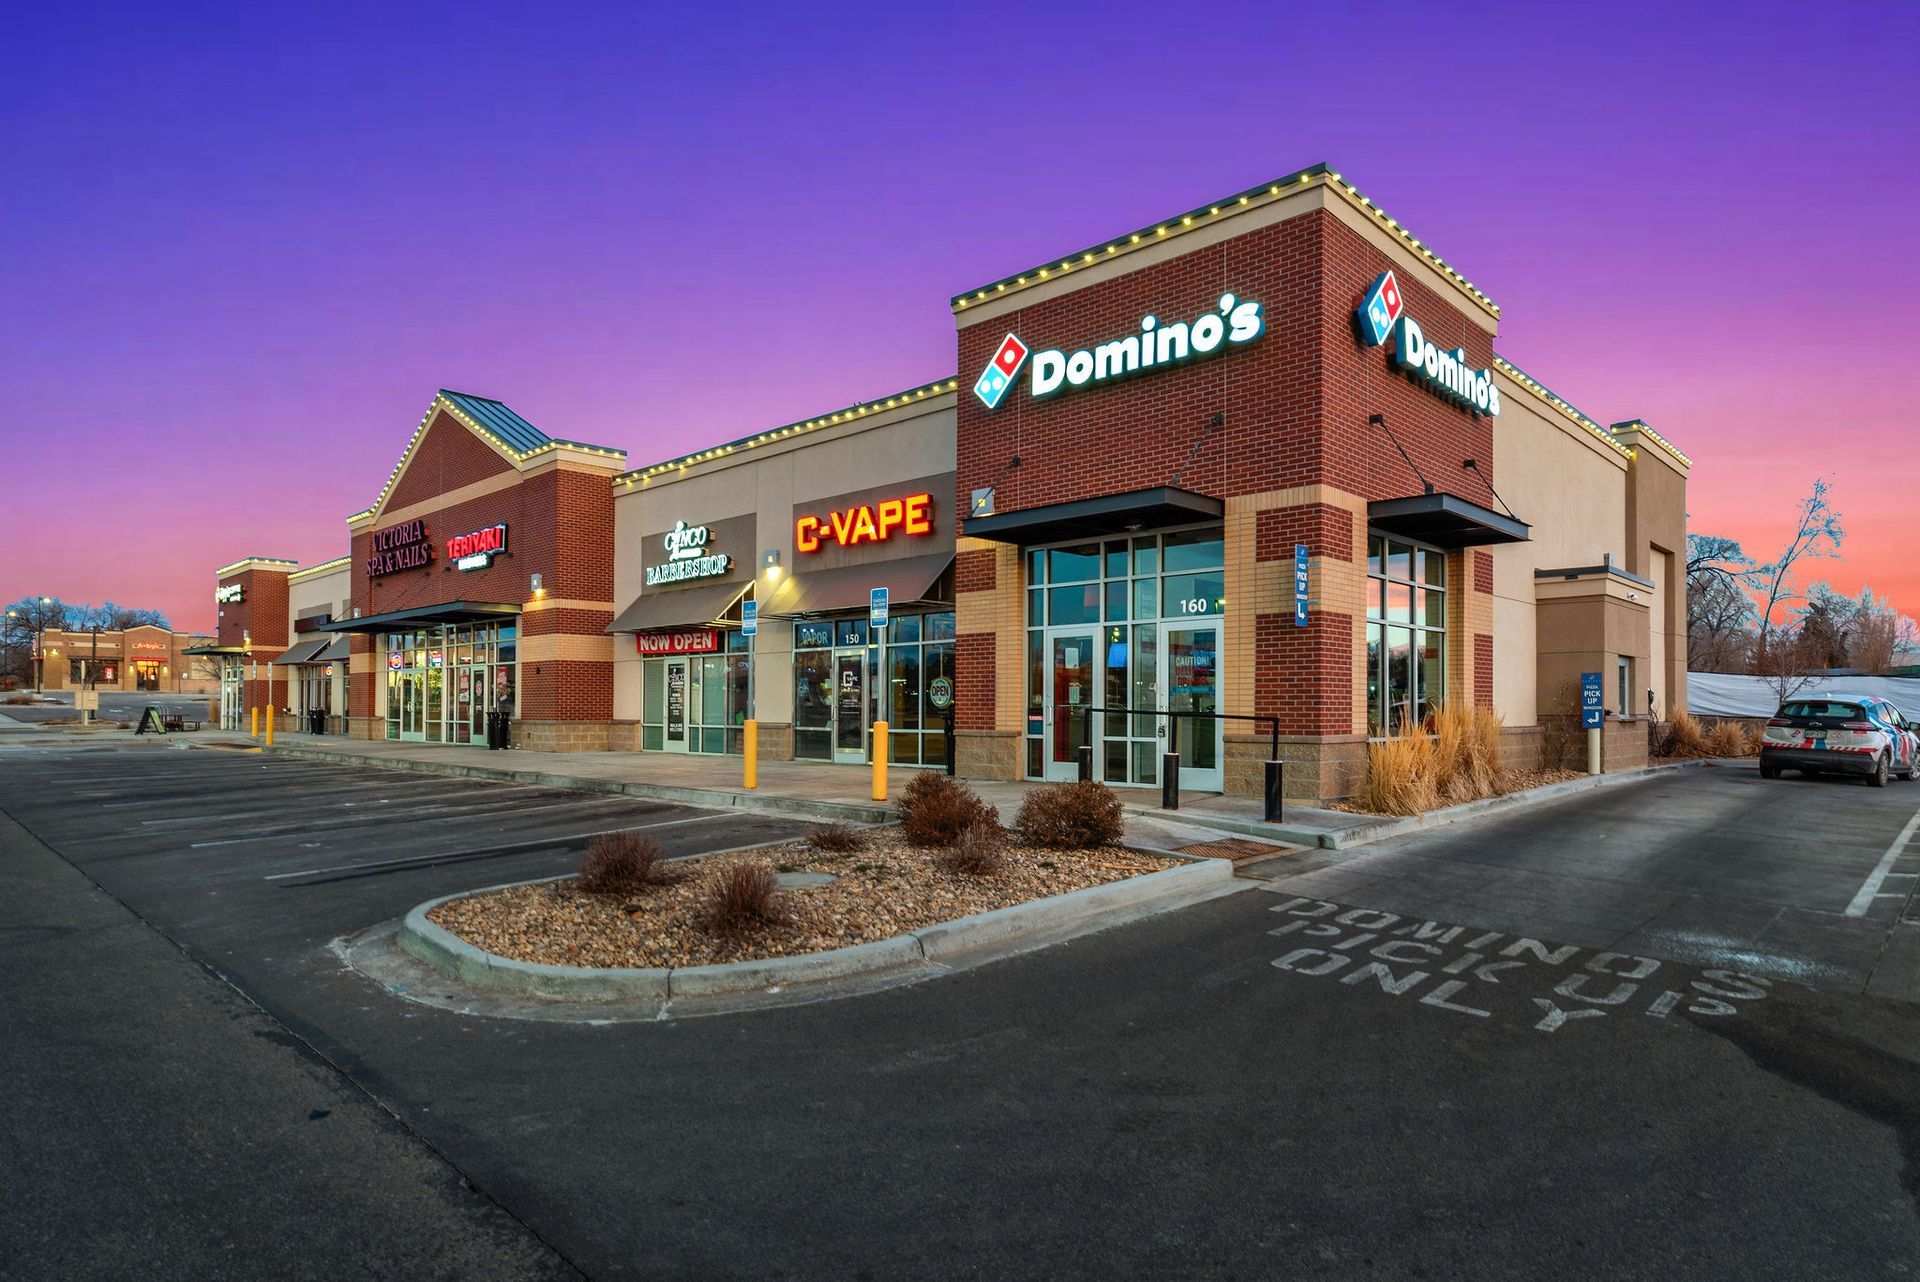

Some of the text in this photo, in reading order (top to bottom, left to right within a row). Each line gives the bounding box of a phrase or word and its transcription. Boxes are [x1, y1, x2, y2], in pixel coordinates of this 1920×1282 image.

[1031, 293, 1261, 397] Domino's
[1404, 316, 1501, 418] Domino's
[373, 520, 422, 552] VICTORIA
[797, 493, 932, 552] C-VAPE
[447, 527, 502, 558] TERIYAKI
[366, 543, 428, 577] SPA & NAILS
[646, 554, 728, 586] BARBERSHOP
[1180, 598, 1208, 613] 160
[640, 632, 713, 651] NOW OPEN
[845, 633, 860, 644] 150
[1584, 690, 1601, 698] PICK
[1269, 948, 1608, 1033] ONLY
